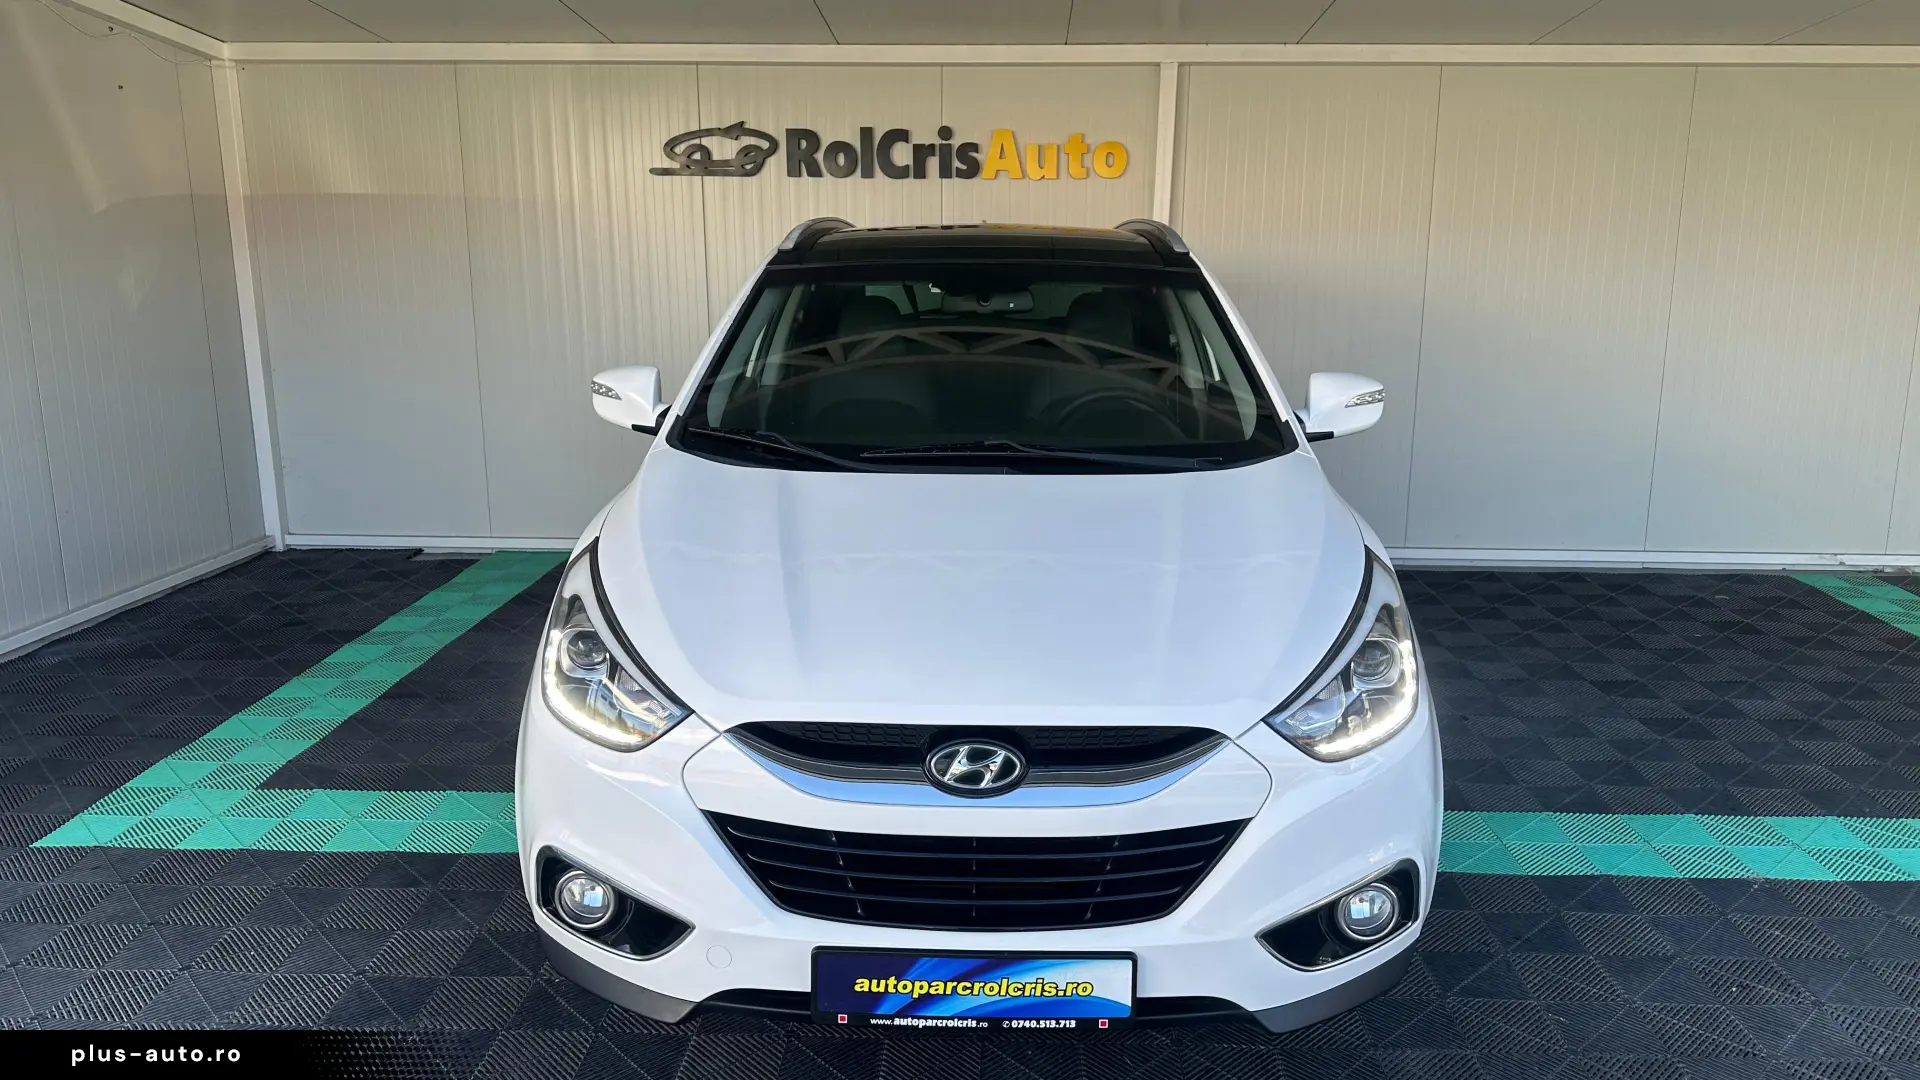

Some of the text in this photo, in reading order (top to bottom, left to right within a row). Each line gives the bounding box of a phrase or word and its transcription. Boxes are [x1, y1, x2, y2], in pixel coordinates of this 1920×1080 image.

[853, 976, 1094, 998] autoparcrolcris.ro
[870, 1017, 1076, 1029] www.autoparcrolcris.ro 0740.513.713
